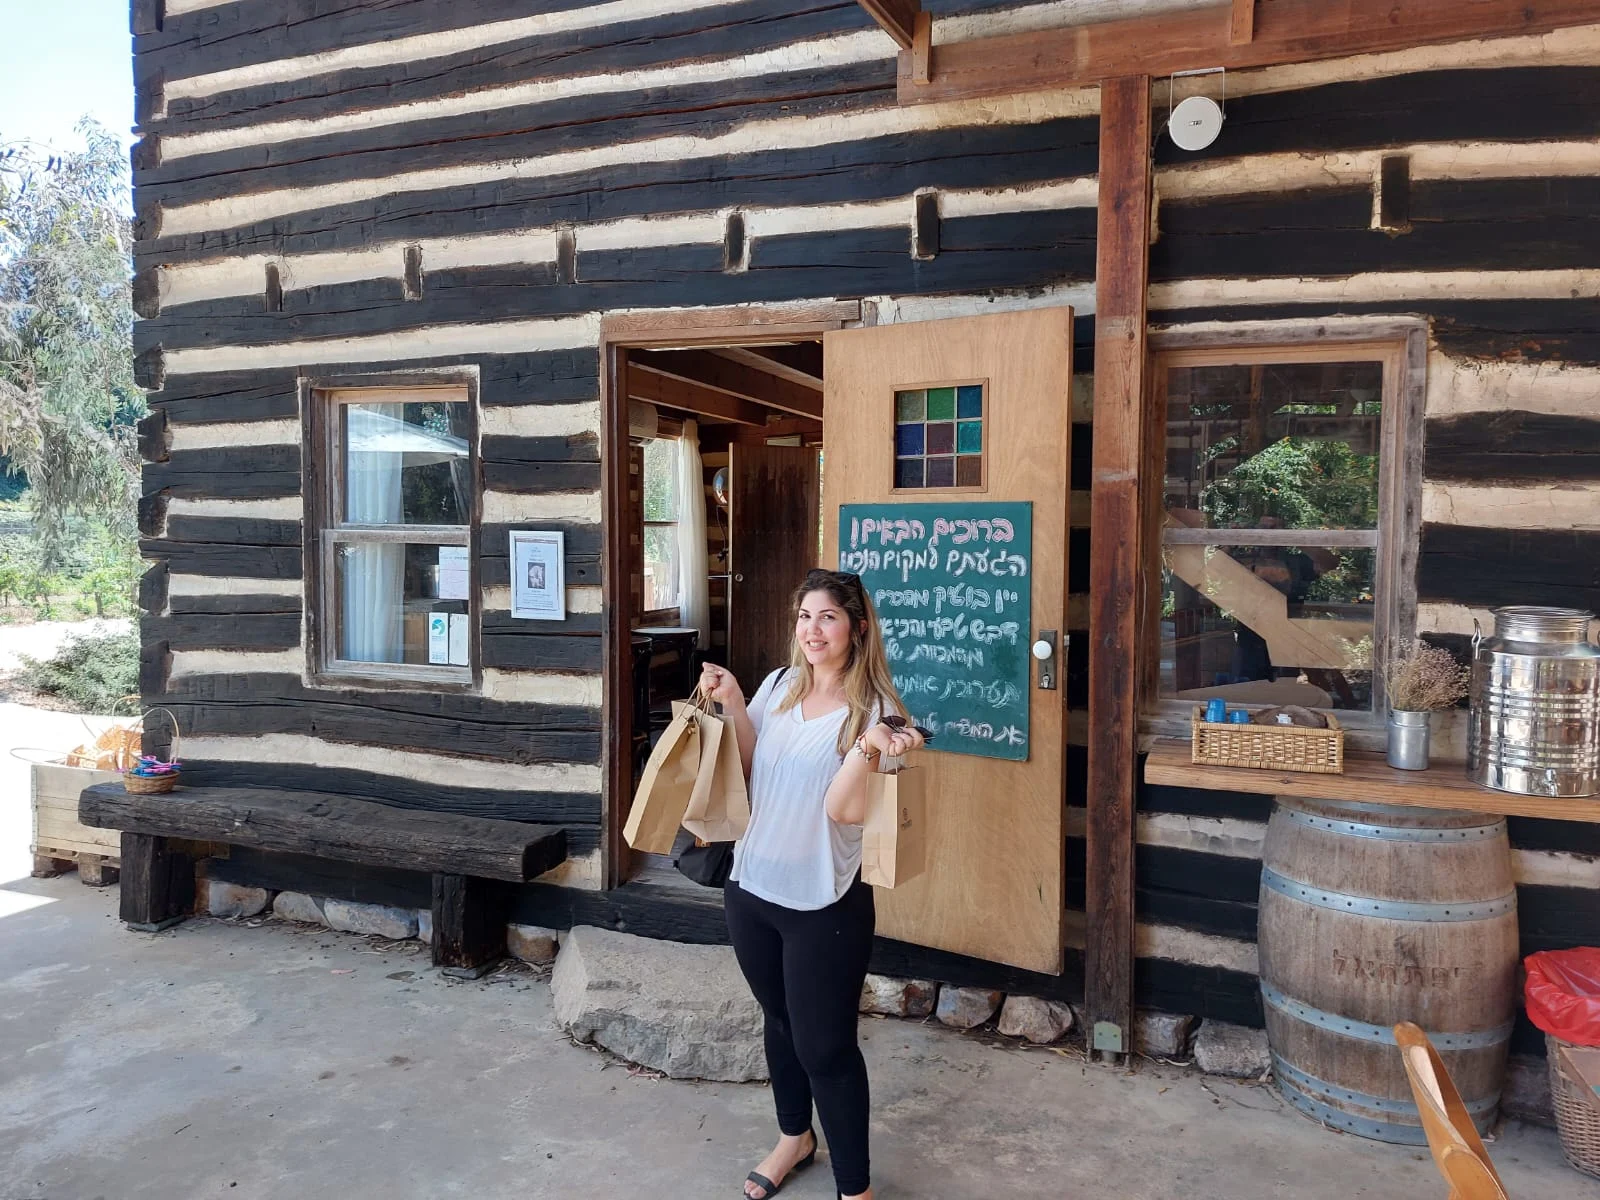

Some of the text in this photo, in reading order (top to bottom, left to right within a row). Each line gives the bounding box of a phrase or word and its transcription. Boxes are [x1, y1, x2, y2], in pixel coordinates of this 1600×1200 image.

[933, 517, 1014, 546] ברוכים
[883, 536, 938, 582] למקום
[945, 547, 1027, 577] הגעתם
[933, 582, 990, 614] בוטיק
[994, 588, 1019, 614] יין
[970, 618, 1020, 646] דבש
[993, 724, 1026, 745] את
